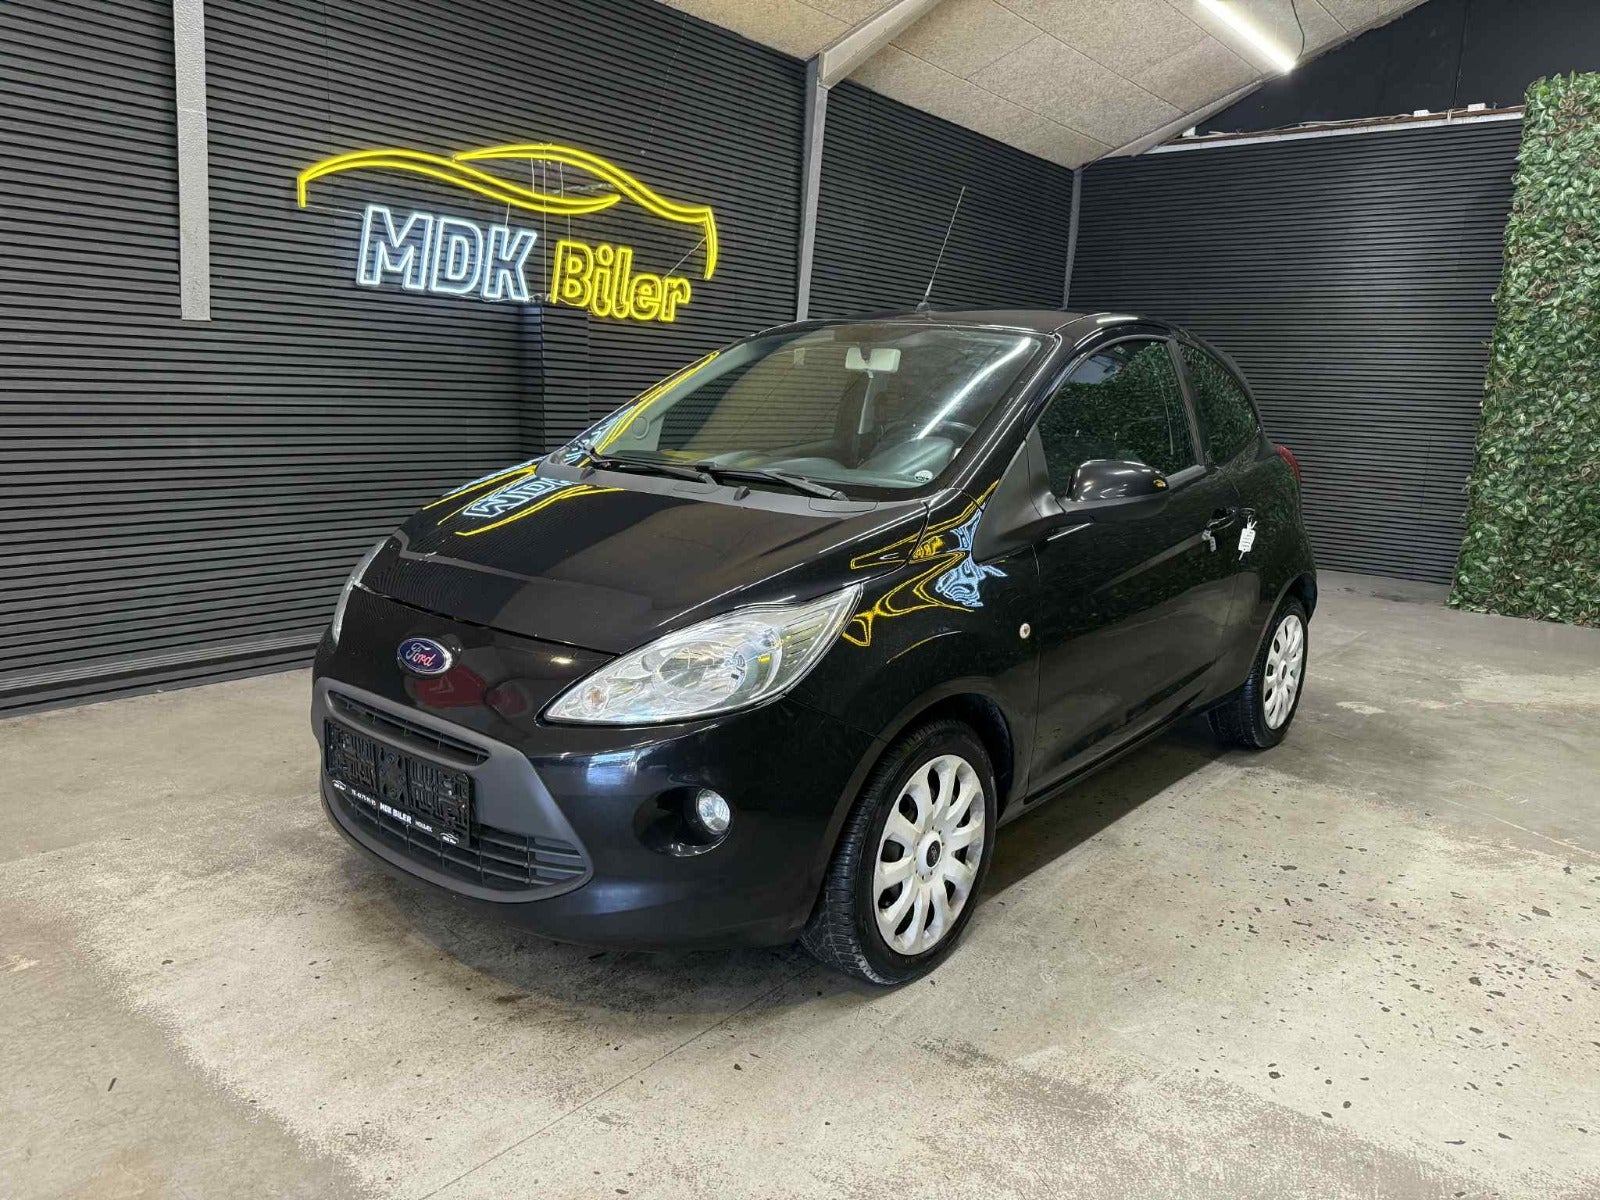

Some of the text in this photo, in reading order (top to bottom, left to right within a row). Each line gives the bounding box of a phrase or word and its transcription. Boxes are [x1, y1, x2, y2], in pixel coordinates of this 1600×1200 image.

[356, 205, 691, 322] MDK Biler
[405, 642, 437, 667] Ford
